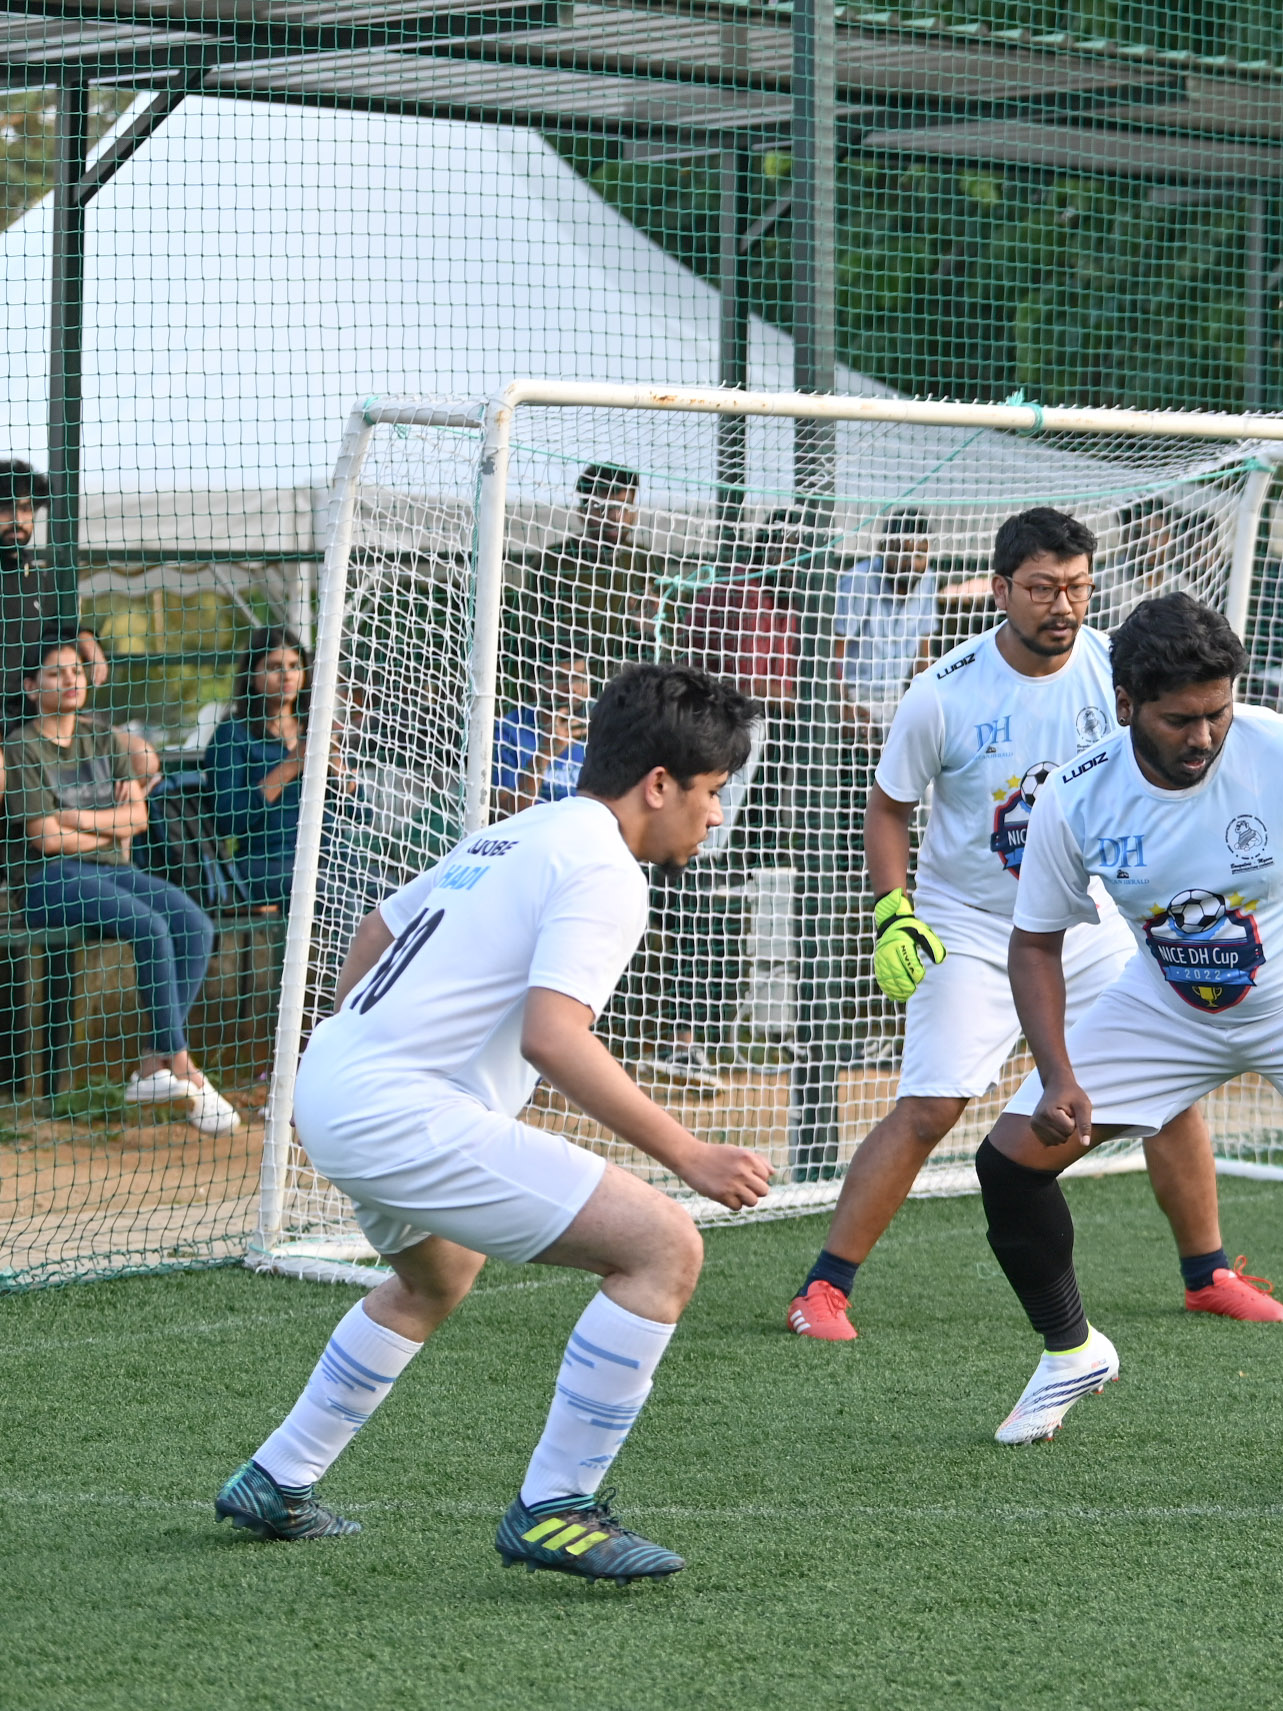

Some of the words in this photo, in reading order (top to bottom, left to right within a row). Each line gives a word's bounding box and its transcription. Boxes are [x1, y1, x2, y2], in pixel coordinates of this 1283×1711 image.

[937, 653, 976, 680] LUDIZ
[974, 714, 1012, 753] DH
[1062, 751, 1109, 784] LUDIZ
[1007, 828, 1027, 847] NIC
[1097, 835, 1147, 868] DH
[438, 863, 491, 891] HADI
[349, 907, 446, 1016] 10
[901, 944, 916, 975] NIVIA
[1158, 944, 1187, 964] NICE
[1188, 948, 1210, 965] DH
[1212, 947, 1239, 968] Cup
[1184, 969, 1221, 980] 2022
